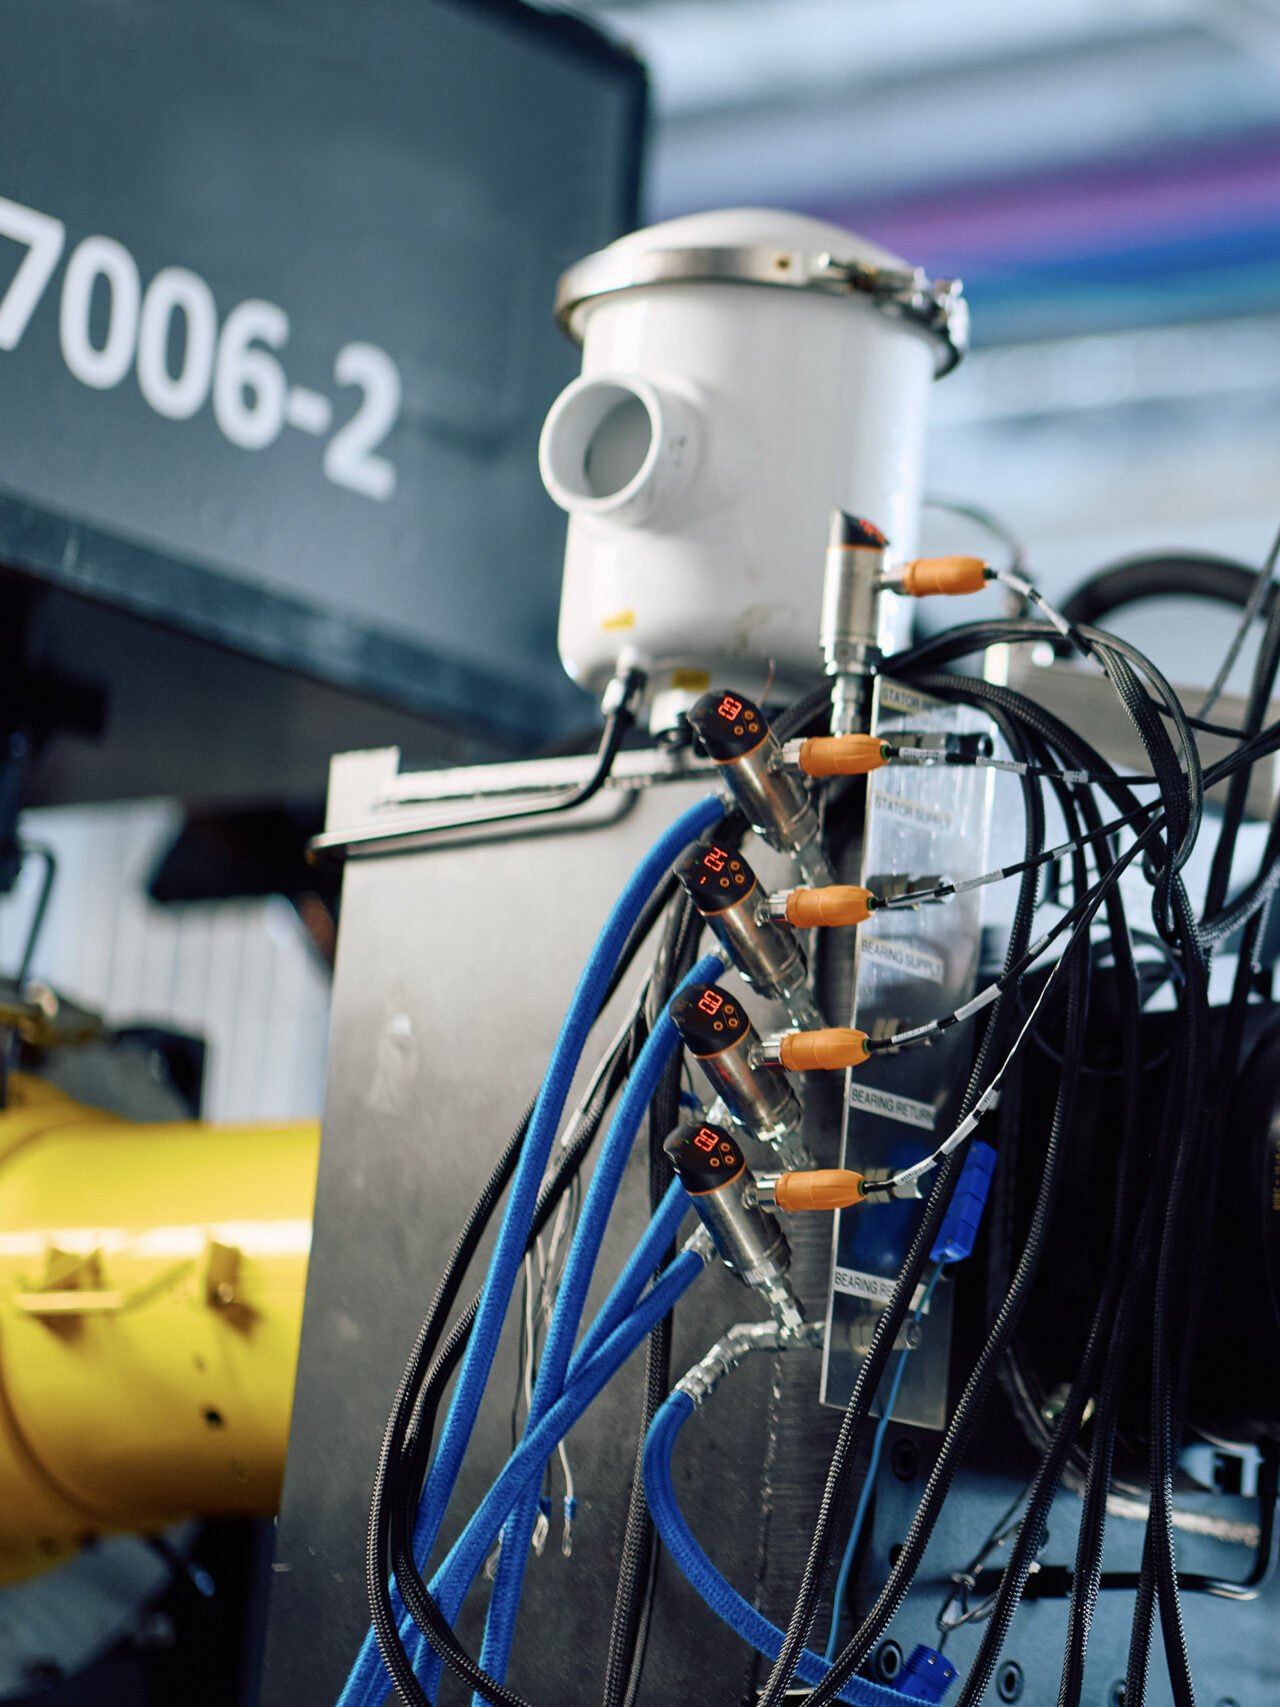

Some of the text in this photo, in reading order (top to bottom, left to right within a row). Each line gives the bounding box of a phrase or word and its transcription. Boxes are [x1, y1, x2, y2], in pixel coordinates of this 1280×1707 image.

[0, 195, 402, 501] 7006-2
[875, 796, 913, 817] STATOR
[862, 940, 942, 977] BEARING SUPPLY
[852, 1087, 933, 1123] BEARING RETURN
[835, 1271, 877, 1294] BEARING
